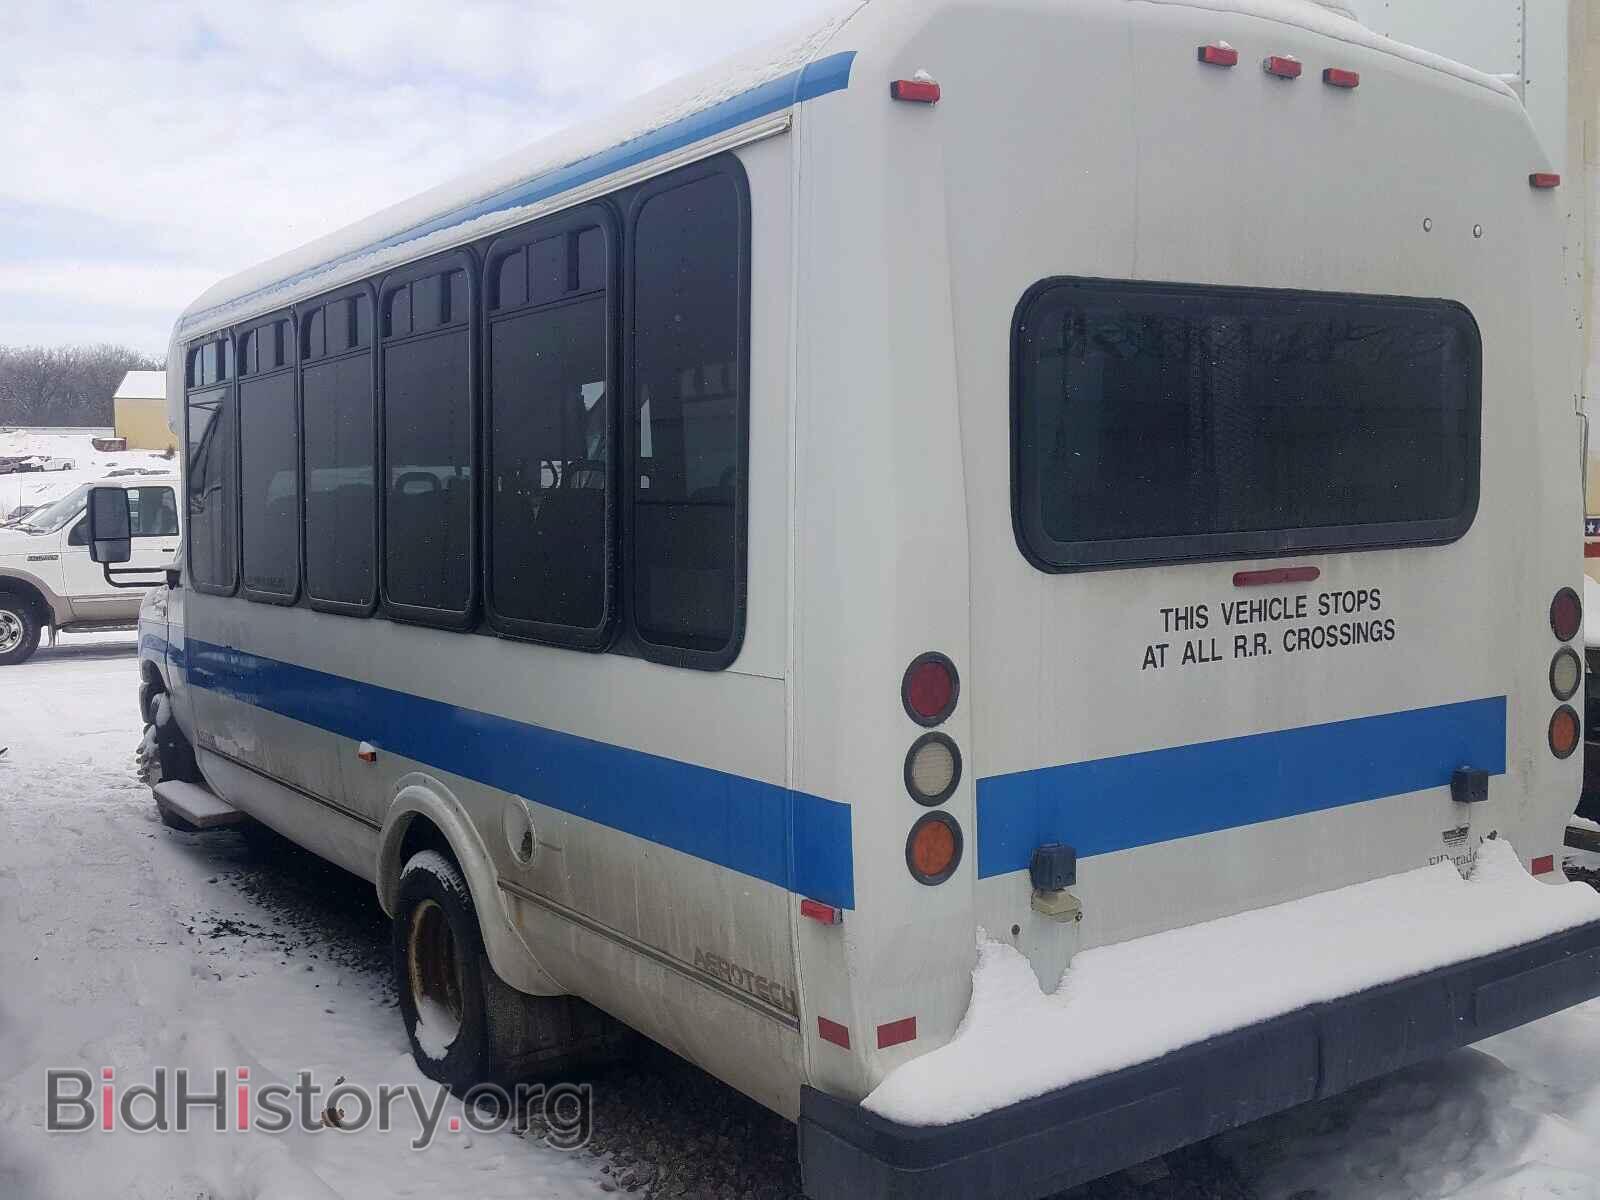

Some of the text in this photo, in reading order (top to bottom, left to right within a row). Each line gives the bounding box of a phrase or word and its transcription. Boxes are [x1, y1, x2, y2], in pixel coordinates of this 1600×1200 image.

[1160, 588, 1381, 633] THIS VEHICLE STOPS
[1142, 619, 1395, 670] AT ALL R.R. CROSSINGS
[693, 946, 799, 1017] AEROTECH
